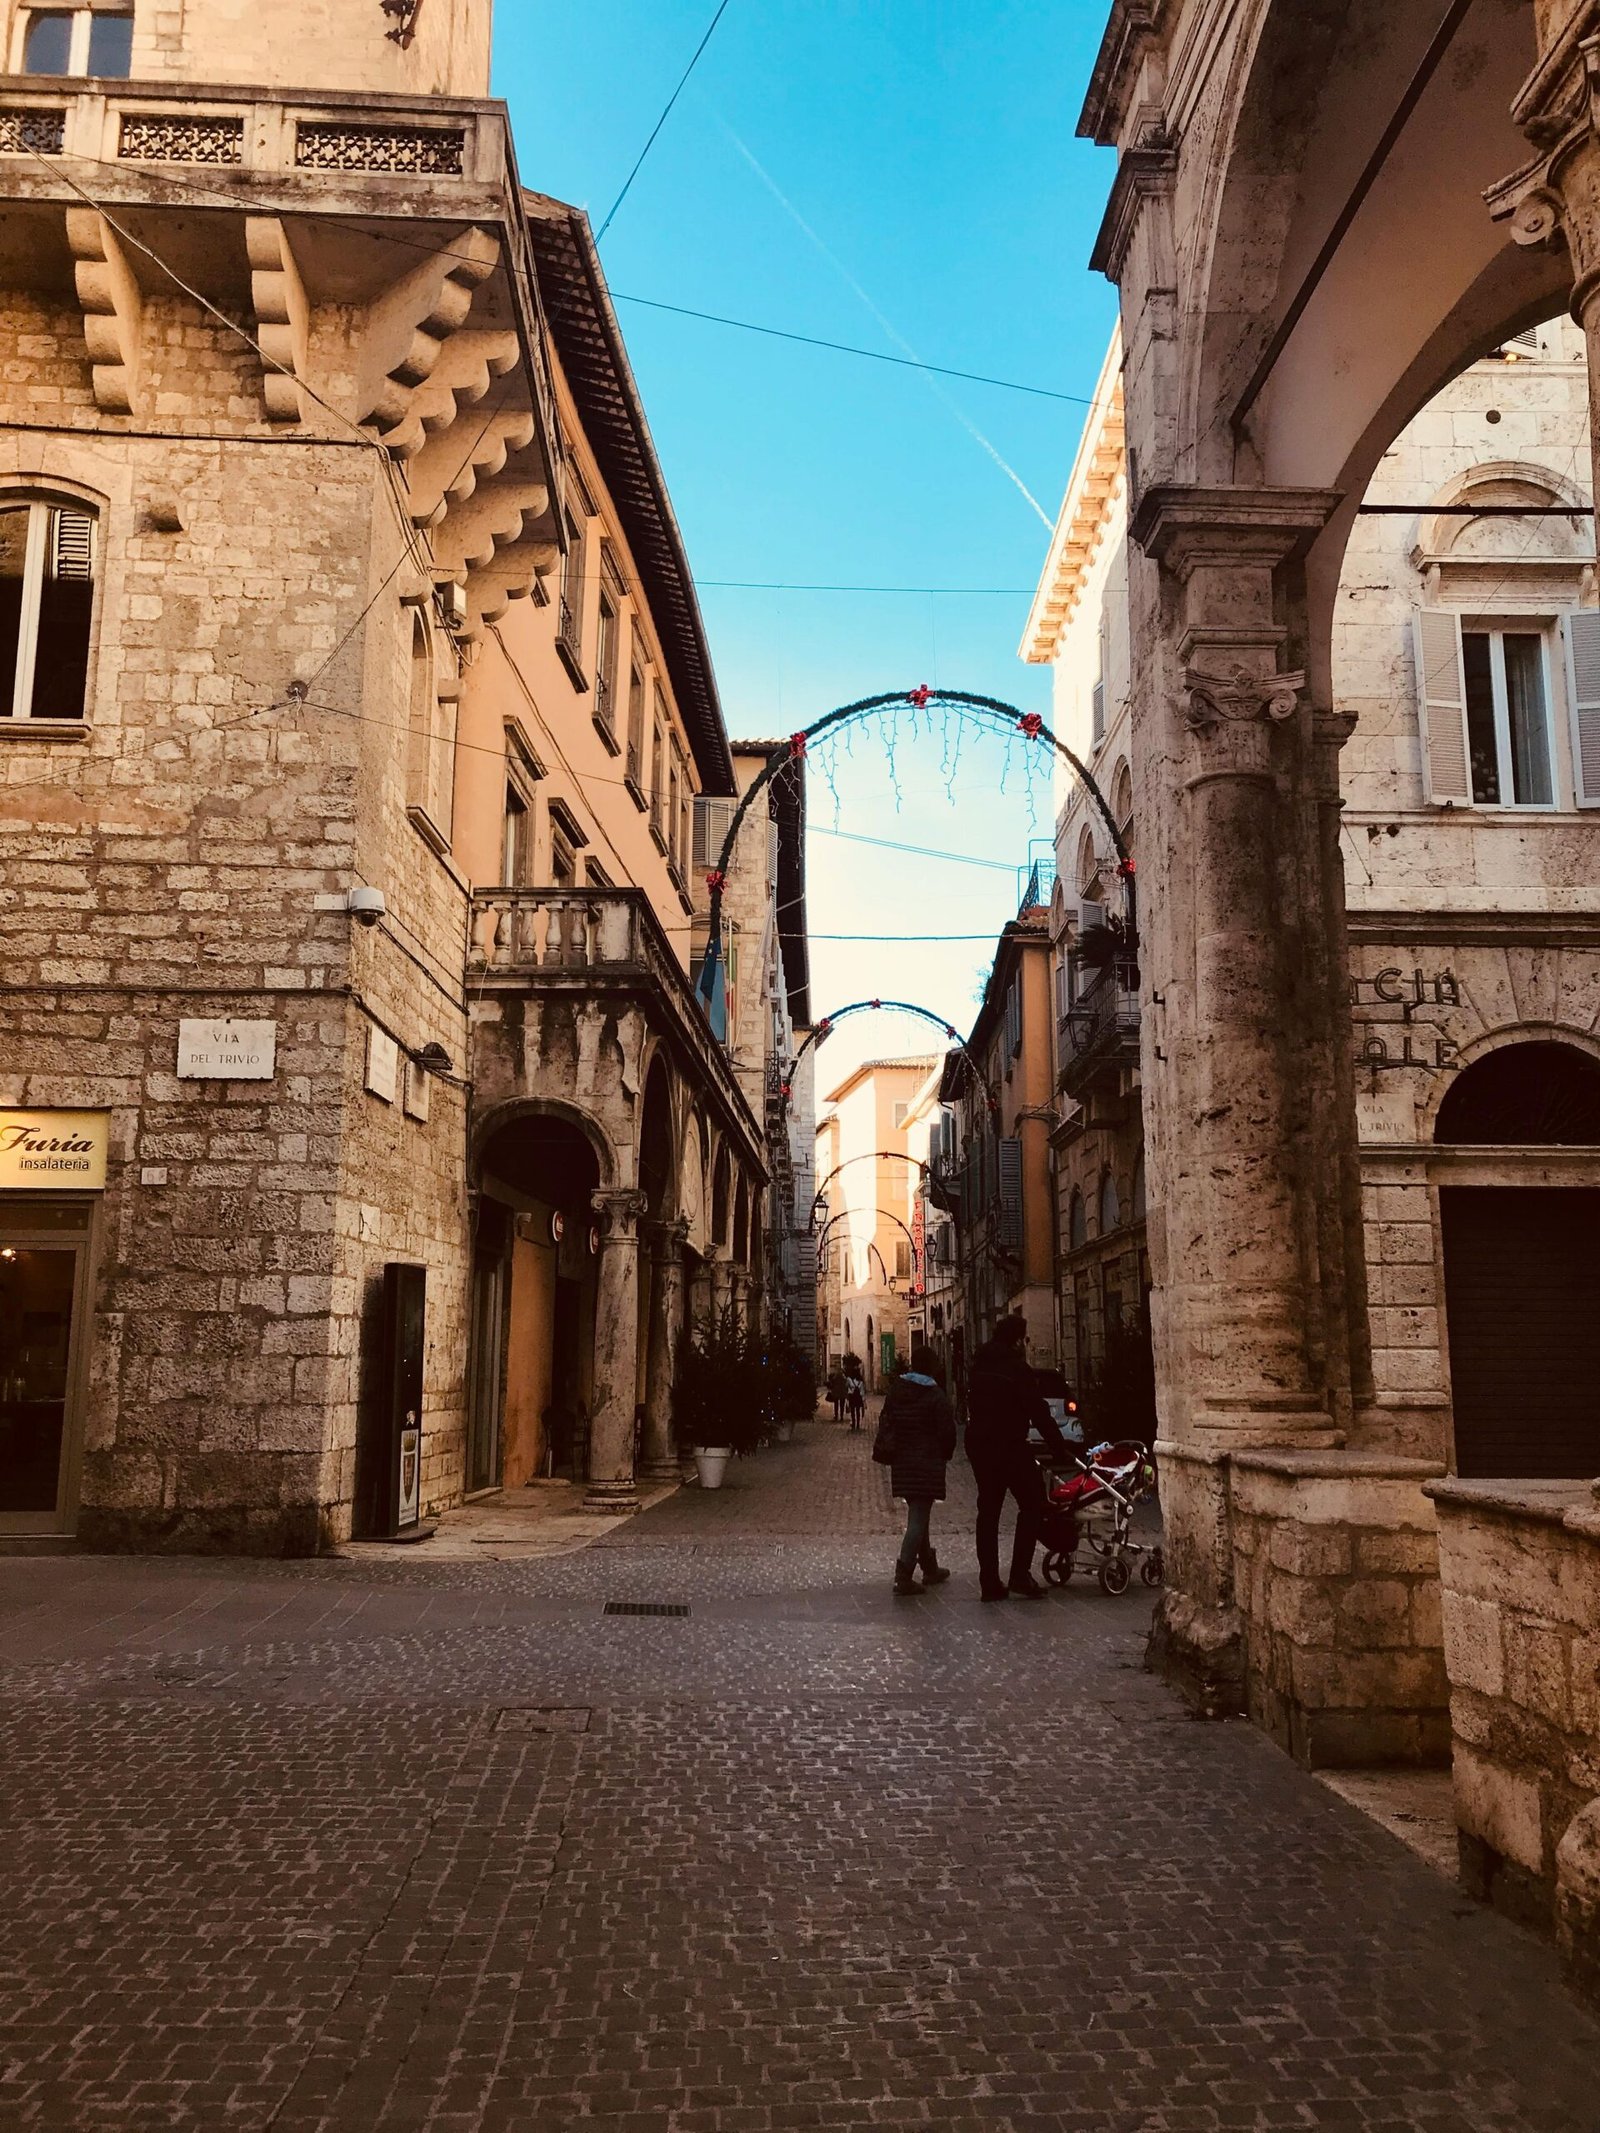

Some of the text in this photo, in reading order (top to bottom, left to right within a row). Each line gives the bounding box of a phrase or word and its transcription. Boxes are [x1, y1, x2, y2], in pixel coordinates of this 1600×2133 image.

[213, 1033, 240, 1043] VIA
[1358, 1036, 1458, 1069] ALE
[190, 1053, 260, 1065] DEL TRIVIO
[1363, 1105, 1384, 1113] VIA
[0, 1125, 95, 1153] Furia
[20, 1157, 90, 1170] insalateria
